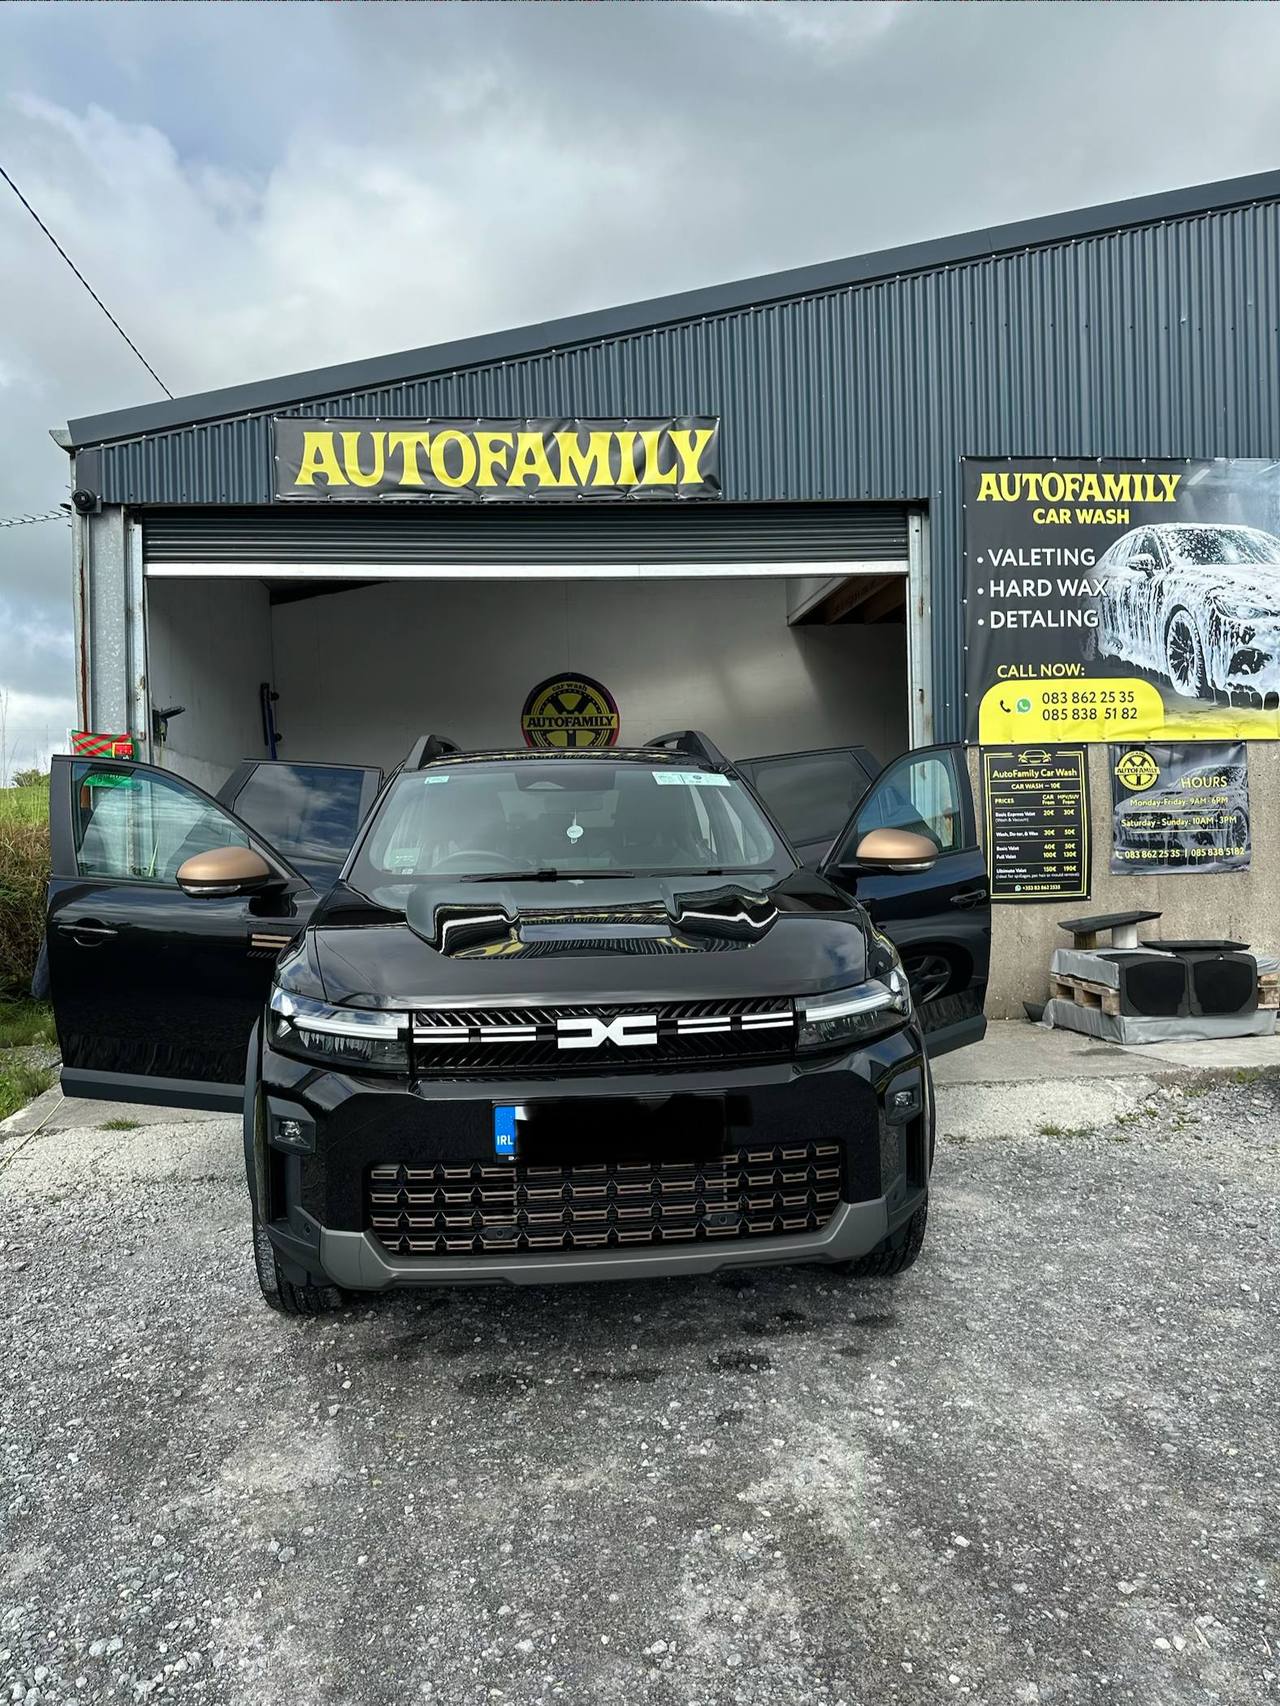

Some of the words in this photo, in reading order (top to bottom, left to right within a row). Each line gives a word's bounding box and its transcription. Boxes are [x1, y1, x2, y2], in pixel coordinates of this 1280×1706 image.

[294, 430, 714, 487] AUTOFAMILY
[976, 472, 1182, 502] AUTOFAMILY
[1032, 508, 1072, 524] CAR
[1075, 508, 1130, 525] WASH
[988, 548, 1096, 567] VALETING
[989, 579, 1053, 598] HARD
[1056, 579, 1109, 597] WAX
[990, 609, 1099, 629] DETALING
[997, 665, 1037, 678] CALL
[1040, 663, 1086, 677] NOW:
[1042, 692, 1068, 704] 083
[1071, 691, 1097, 703] 862
[1100, 691, 1116, 703] 25
[1119, 691, 1135, 703] 35
[1042, 709, 1068, 721] 085
[1071, 708, 1098, 720] 838
[1104, 708, 1118, 720] 51
[1121, 708, 1138, 720] 82
[527, 715, 615, 728] AUTOFAMILY
[992, 769, 1040, 778] AutoFamily
[1040, 769, 1055, 777] Car
[1055, 768, 1078, 777] Wash
[1181, 776, 1228, 788] HOURS
[1190, 797, 1207, 805] 9AM
[1121, 819, 1156, 828] Saturday
[1192, 817, 1214, 825] 10AM
[1219, 816, 1237, 824] 3PM
[1124, 850, 1140, 859] 083
[1141, 850, 1157, 858] 862
[1191, 848, 1206, 857] 085
[1207, 847, 1224, 856] 838
[496, 1134, 514, 1146] IRL
